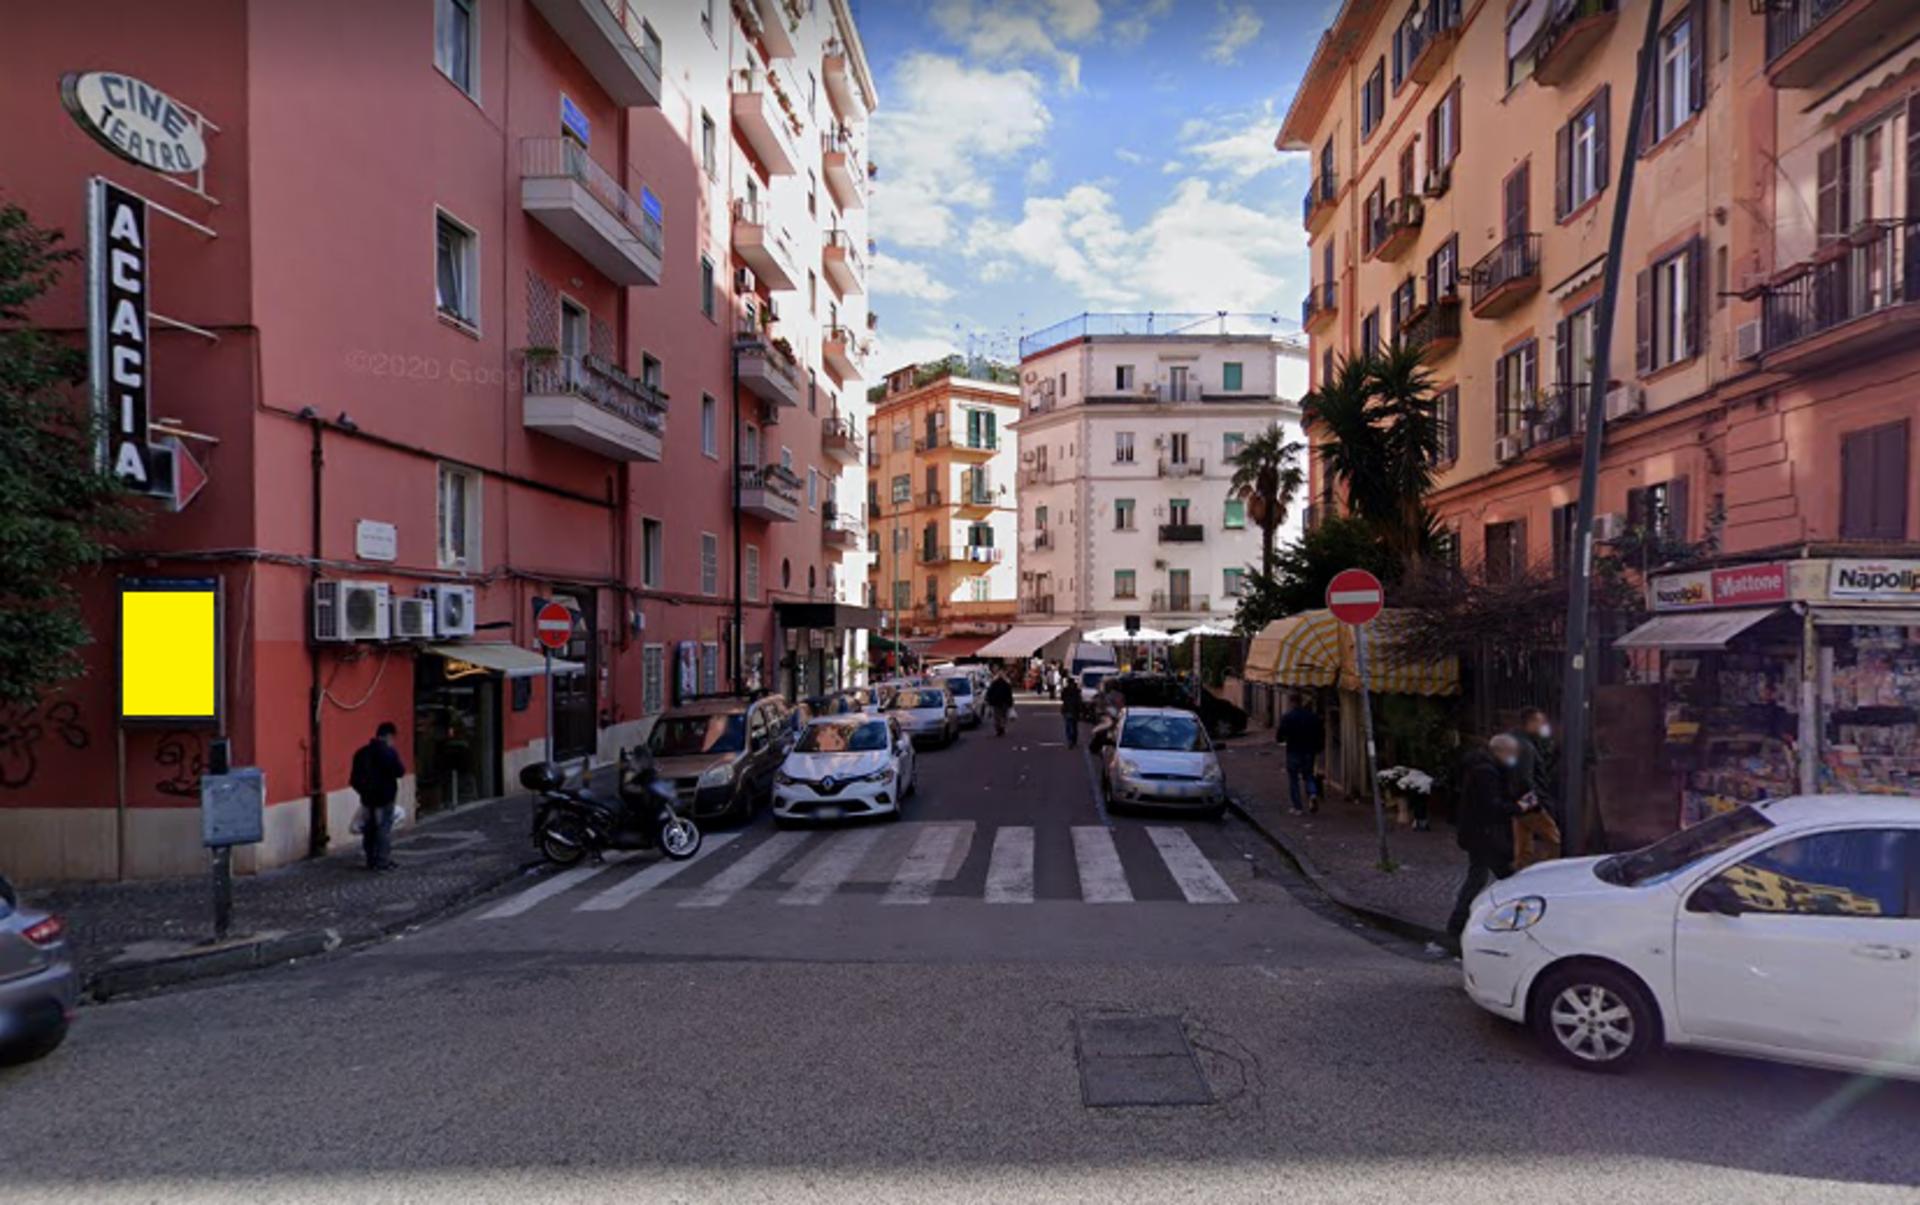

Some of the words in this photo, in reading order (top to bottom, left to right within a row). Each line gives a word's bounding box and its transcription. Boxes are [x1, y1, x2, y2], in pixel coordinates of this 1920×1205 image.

[99, 104, 193, 170] TEATRO
[101, 75, 188, 140] CINE
[110, 204, 147, 482] ACACIA
